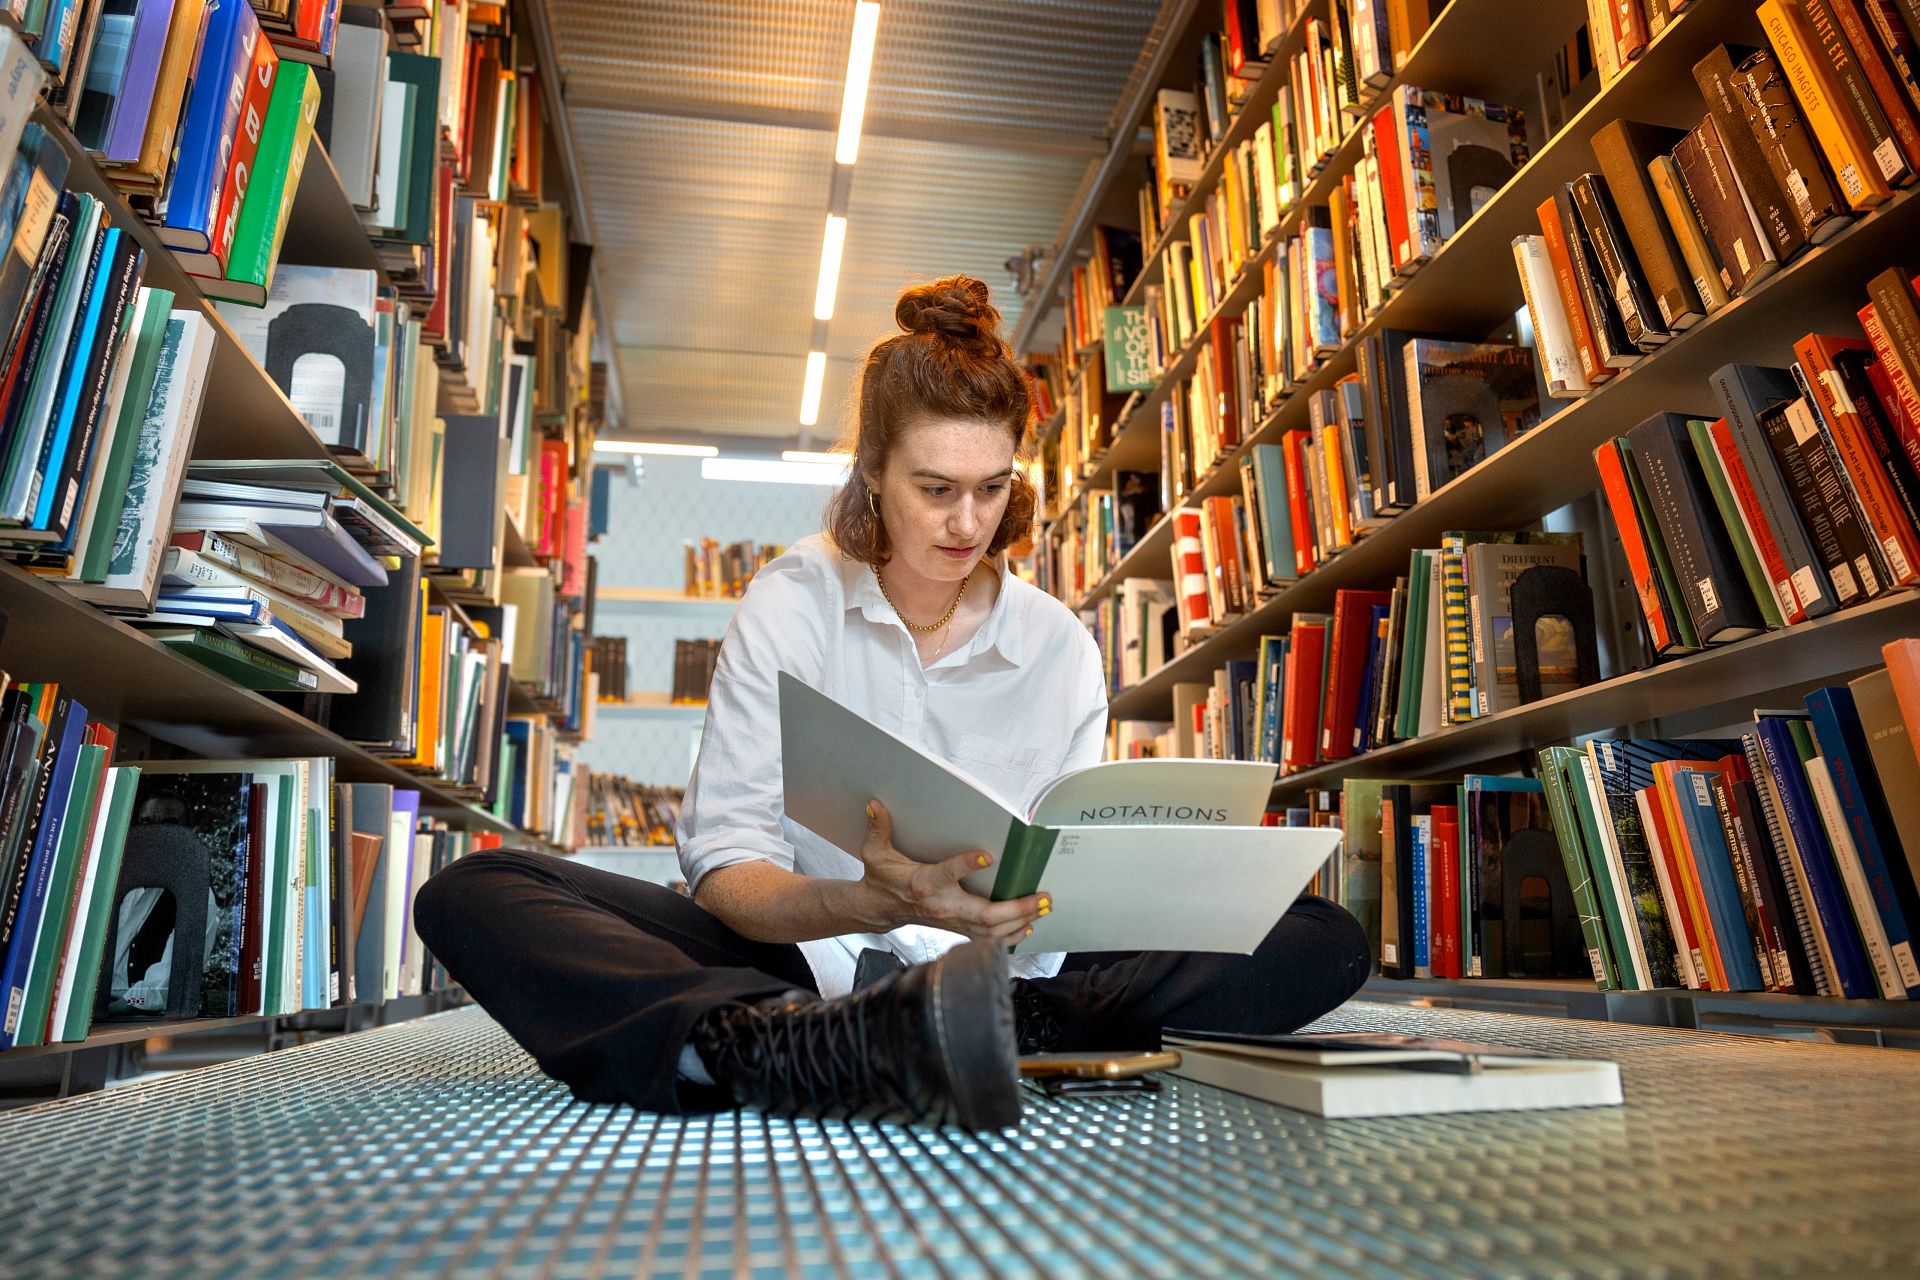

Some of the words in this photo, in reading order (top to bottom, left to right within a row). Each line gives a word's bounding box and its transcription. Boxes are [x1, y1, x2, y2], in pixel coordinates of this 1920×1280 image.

[1805, 0, 1835, 50] RIVATE
[1828, 42, 1848, 71] EYE
[1768, 16, 1797, 63] CHICAGO
[1790, 63, 1821, 111] IMAGISTS
[1751, 89, 1763, 102] Elite
[1759, 106, 1769, 116] the
[1762, 115, 1779, 138] Obscure
[1866, 119, 1880, 137] CHICAGO
[1694, 128, 1708, 149] Reading
[1703, 147, 1715, 167] Abstract
[1710, 166, 1728, 201] Expressionism
[91, 230, 105, 266] ROMARE
[1592, 227, 1608, 250] Abstract
[122, 254, 135, 282] Writing
[81, 268, 95, 305] BEARDEN
[112, 296, 124, 324] Future:
[1568, 307, 1576, 315] OF
[103, 324, 117, 359] Basquiat
[1887, 308, 1900, 324] State
[1902, 339, 1912, 351] Art
[100, 359, 108, 374] and
[1503, 349, 1529, 366] Art
[1802, 349, 1822, 379] Monster
[1716, 377, 1733, 400] GRAPHIC
[1815, 377, 1833, 404] Roster:
[86, 389, 104, 424] Hip-Hop
[1766, 413, 1786, 428] TERR
[1769, 423, 1789, 436] SMIT
[1826, 403, 1854, 452] Existentialist
[74, 425, 94, 472] Generation
[1847, 450, 1859, 465] Art
[1853, 464, 1862, 473] in
[1807, 444, 1823, 471] THE
[1815, 466, 1839, 503] LIVING
[1829, 498, 1852, 528] LINE
[1856, 472, 1876, 504] Postwar
[1781, 444, 1810, 487] MAKING
[1800, 489, 1821, 512] THE
[1811, 512, 1843, 560] MODERN
[1653, 458, 1674, 495] MODERN
[1681, 543, 1699, 578] AMERIC
[1870, 502, 1890, 534] Chicago
[1502, 554, 1555, 564] DIFFERENT
[1541, 753, 1561, 786] art:21
[1761, 737, 1777, 765] RIVER
[1770, 766, 1798, 823] CROSSINGS
[1080, 805, 1228, 822] NOTATIONS
[1715, 786, 1728, 811] INSIDE
[44, 817, 59, 848] LOUISE
[1722, 812, 1732, 827] THE
[1726, 828, 1741, 862] ARTIST'S
[1826, 811, 1837, 832] STATES
[1836, 843, 1851, 871] AMERICA
[32, 849, 52, 896] BOURGEOIS
[1735, 863, 1748, 892] STUDIO
